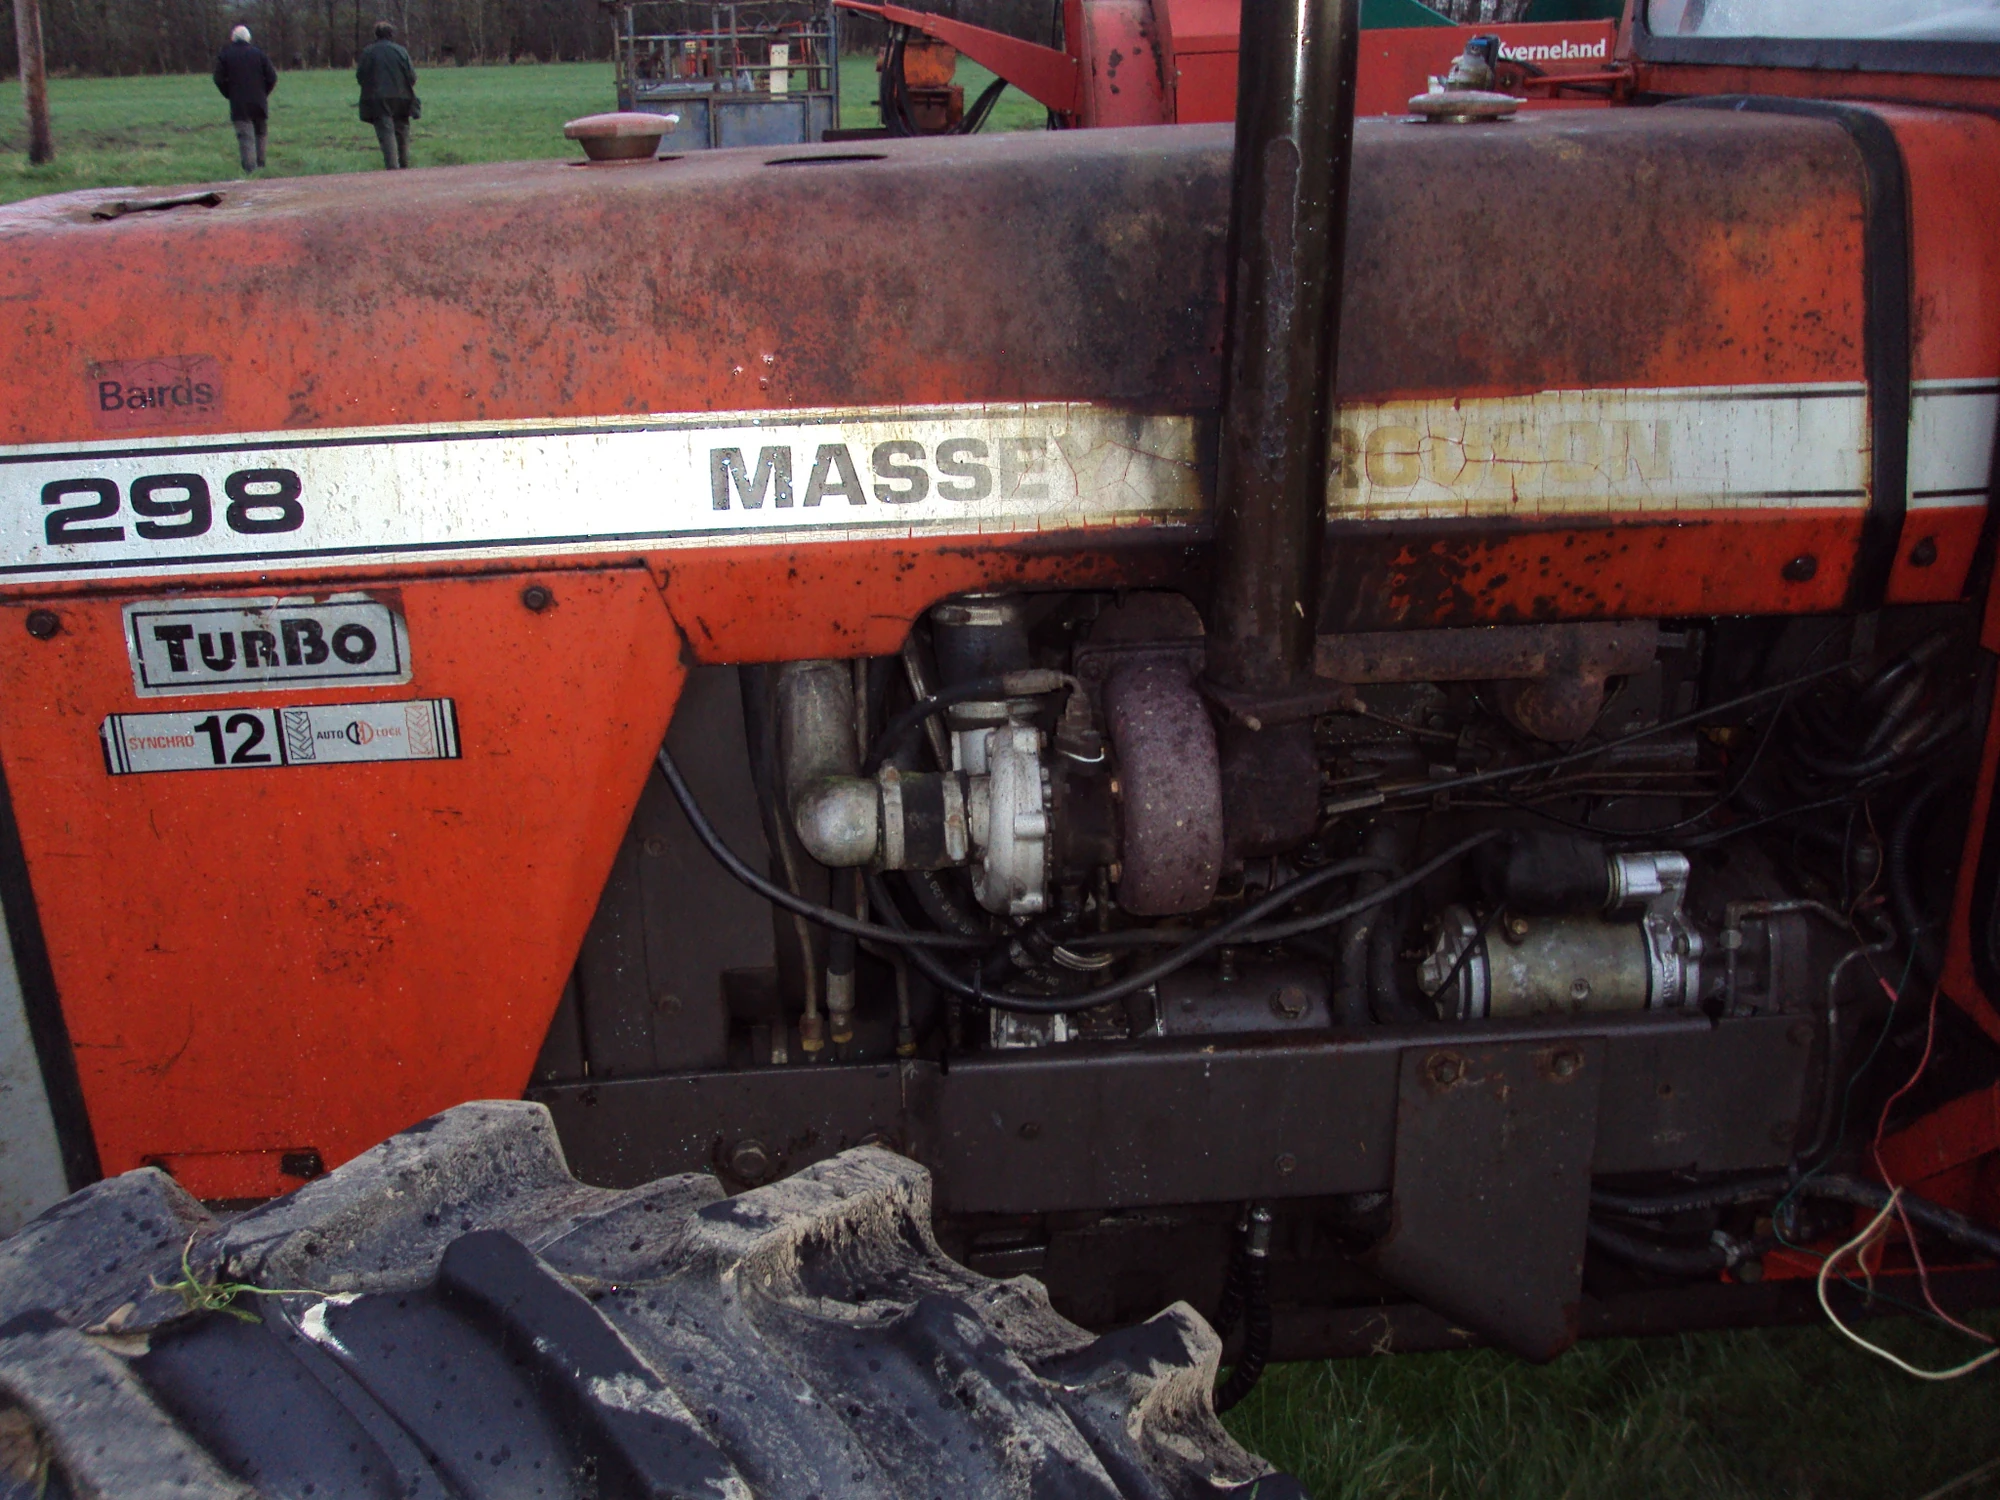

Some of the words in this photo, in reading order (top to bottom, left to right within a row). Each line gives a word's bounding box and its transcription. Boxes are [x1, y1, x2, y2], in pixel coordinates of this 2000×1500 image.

[1498, 38, 1606, 60] Kverneland
[98, 376, 214, 411] Bairds
[41, 468, 305, 546] 298
[153, 618, 377, 673] TURBO
[128, 735, 195, 750] SYNCHRO
[194, 713, 272, 765] 12
[316, 730, 344, 740] AUTO
[376, 727, 402, 737] LOCK
